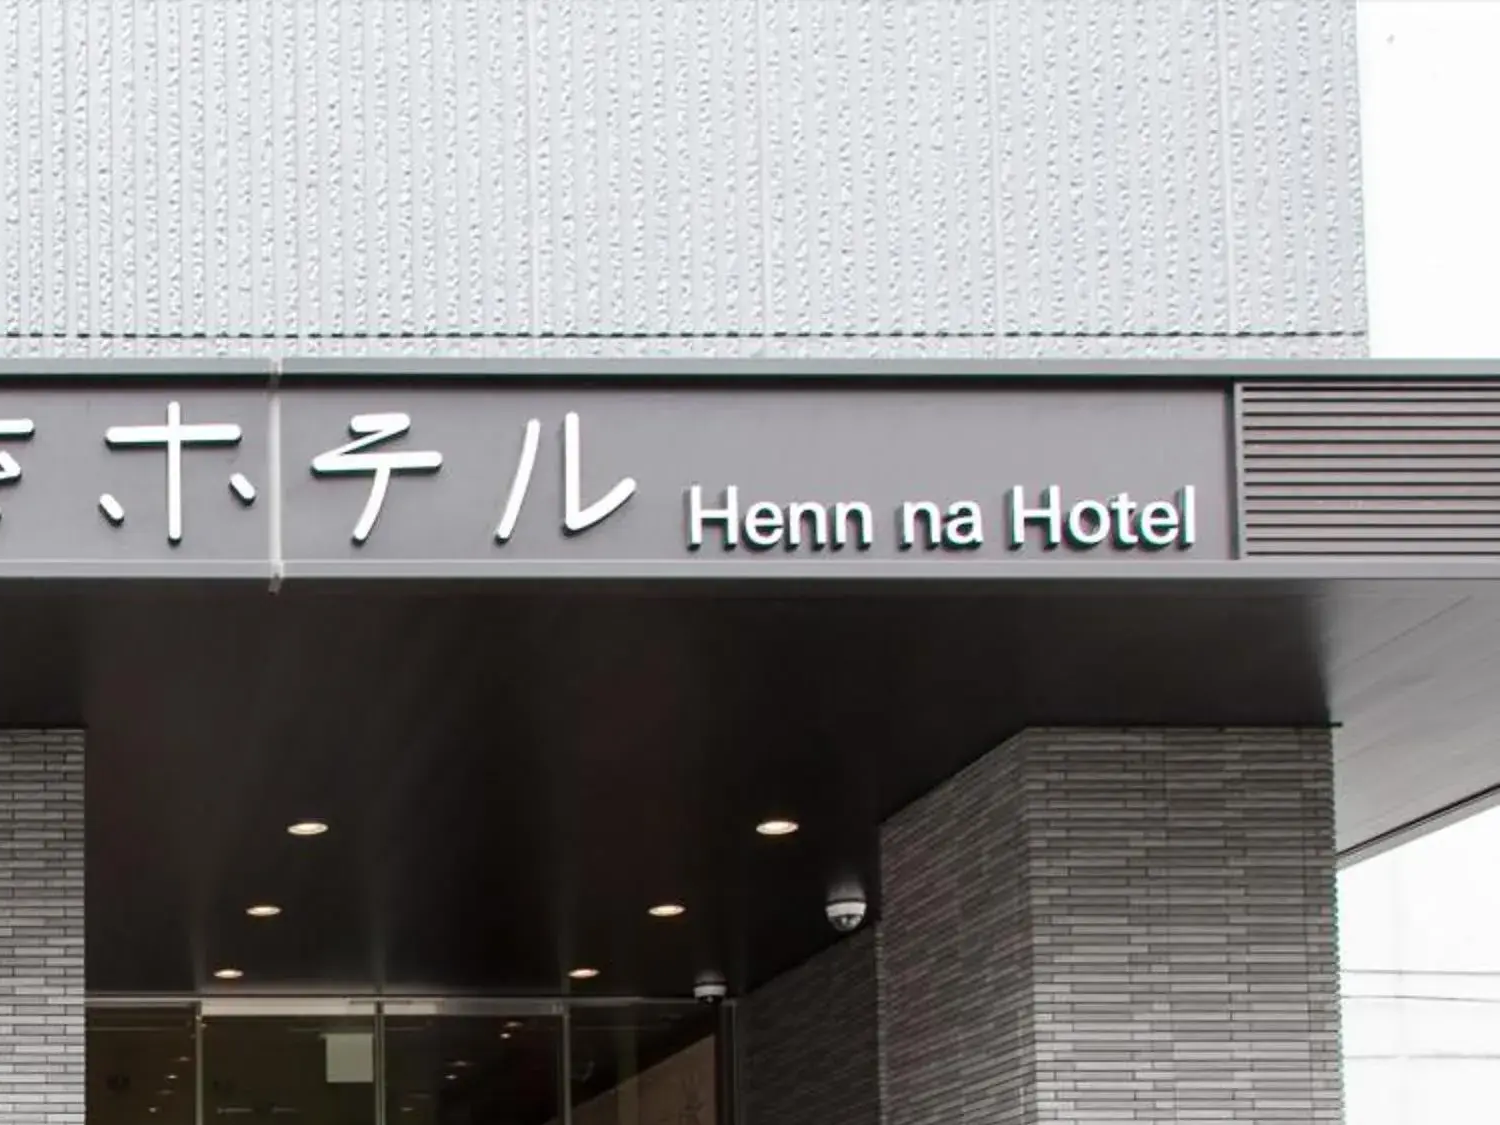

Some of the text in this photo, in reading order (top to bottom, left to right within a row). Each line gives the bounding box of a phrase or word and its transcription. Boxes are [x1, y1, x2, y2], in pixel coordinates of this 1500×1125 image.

[686, 484, 1197, 548] Henn na Hotel
